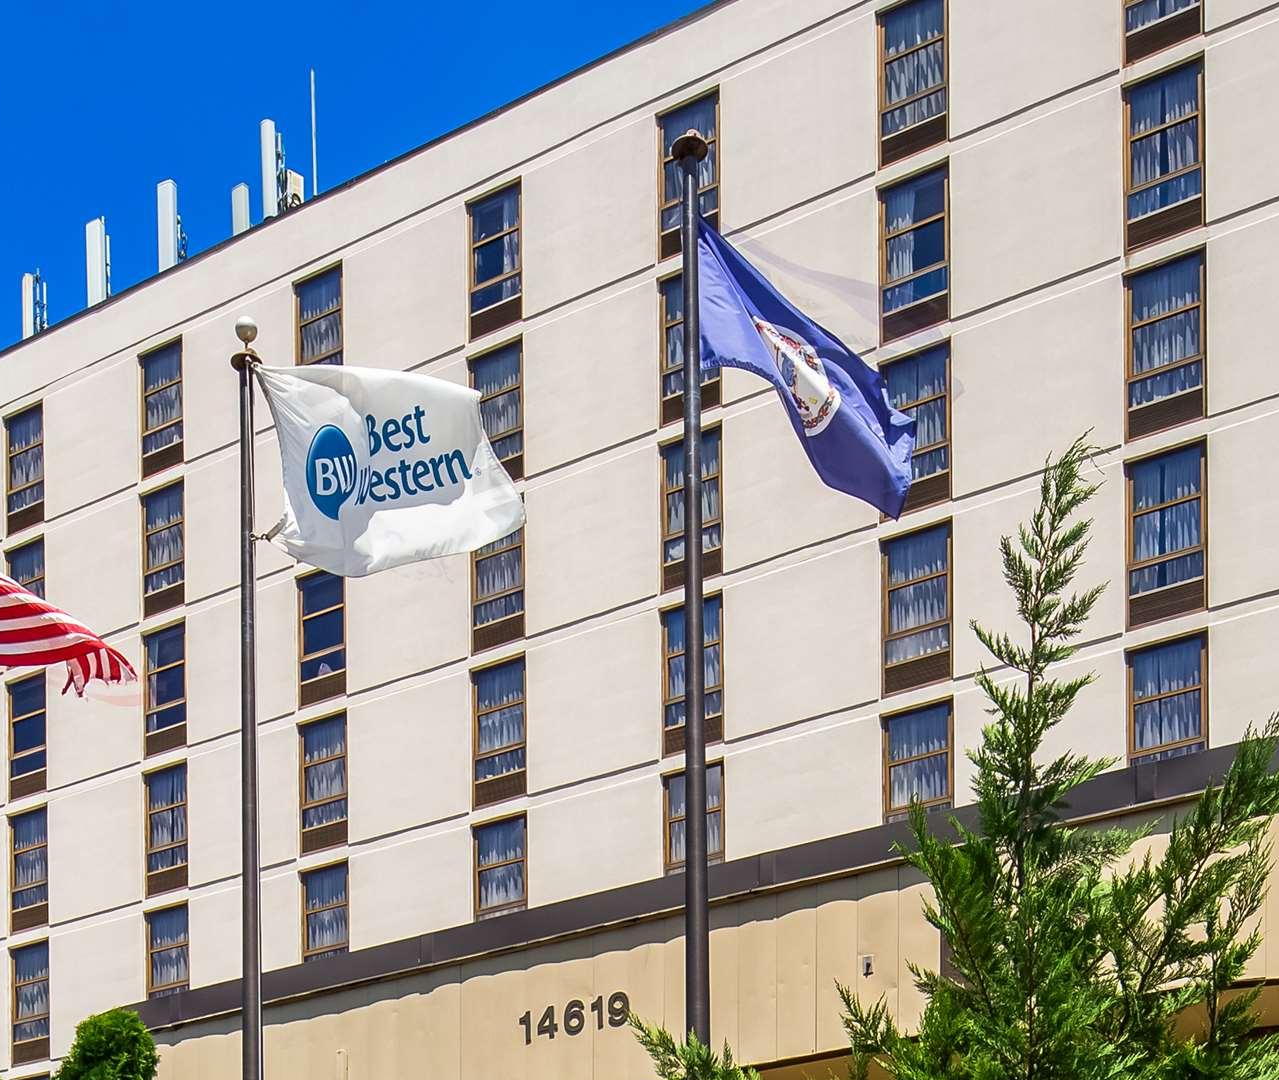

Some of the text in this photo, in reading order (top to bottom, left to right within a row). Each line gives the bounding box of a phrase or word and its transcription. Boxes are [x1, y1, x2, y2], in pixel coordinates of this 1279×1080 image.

[365, 405, 431, 457] Best
[315, 454, 355, 497] BW
[519, 991, 630, 1046] 14619
